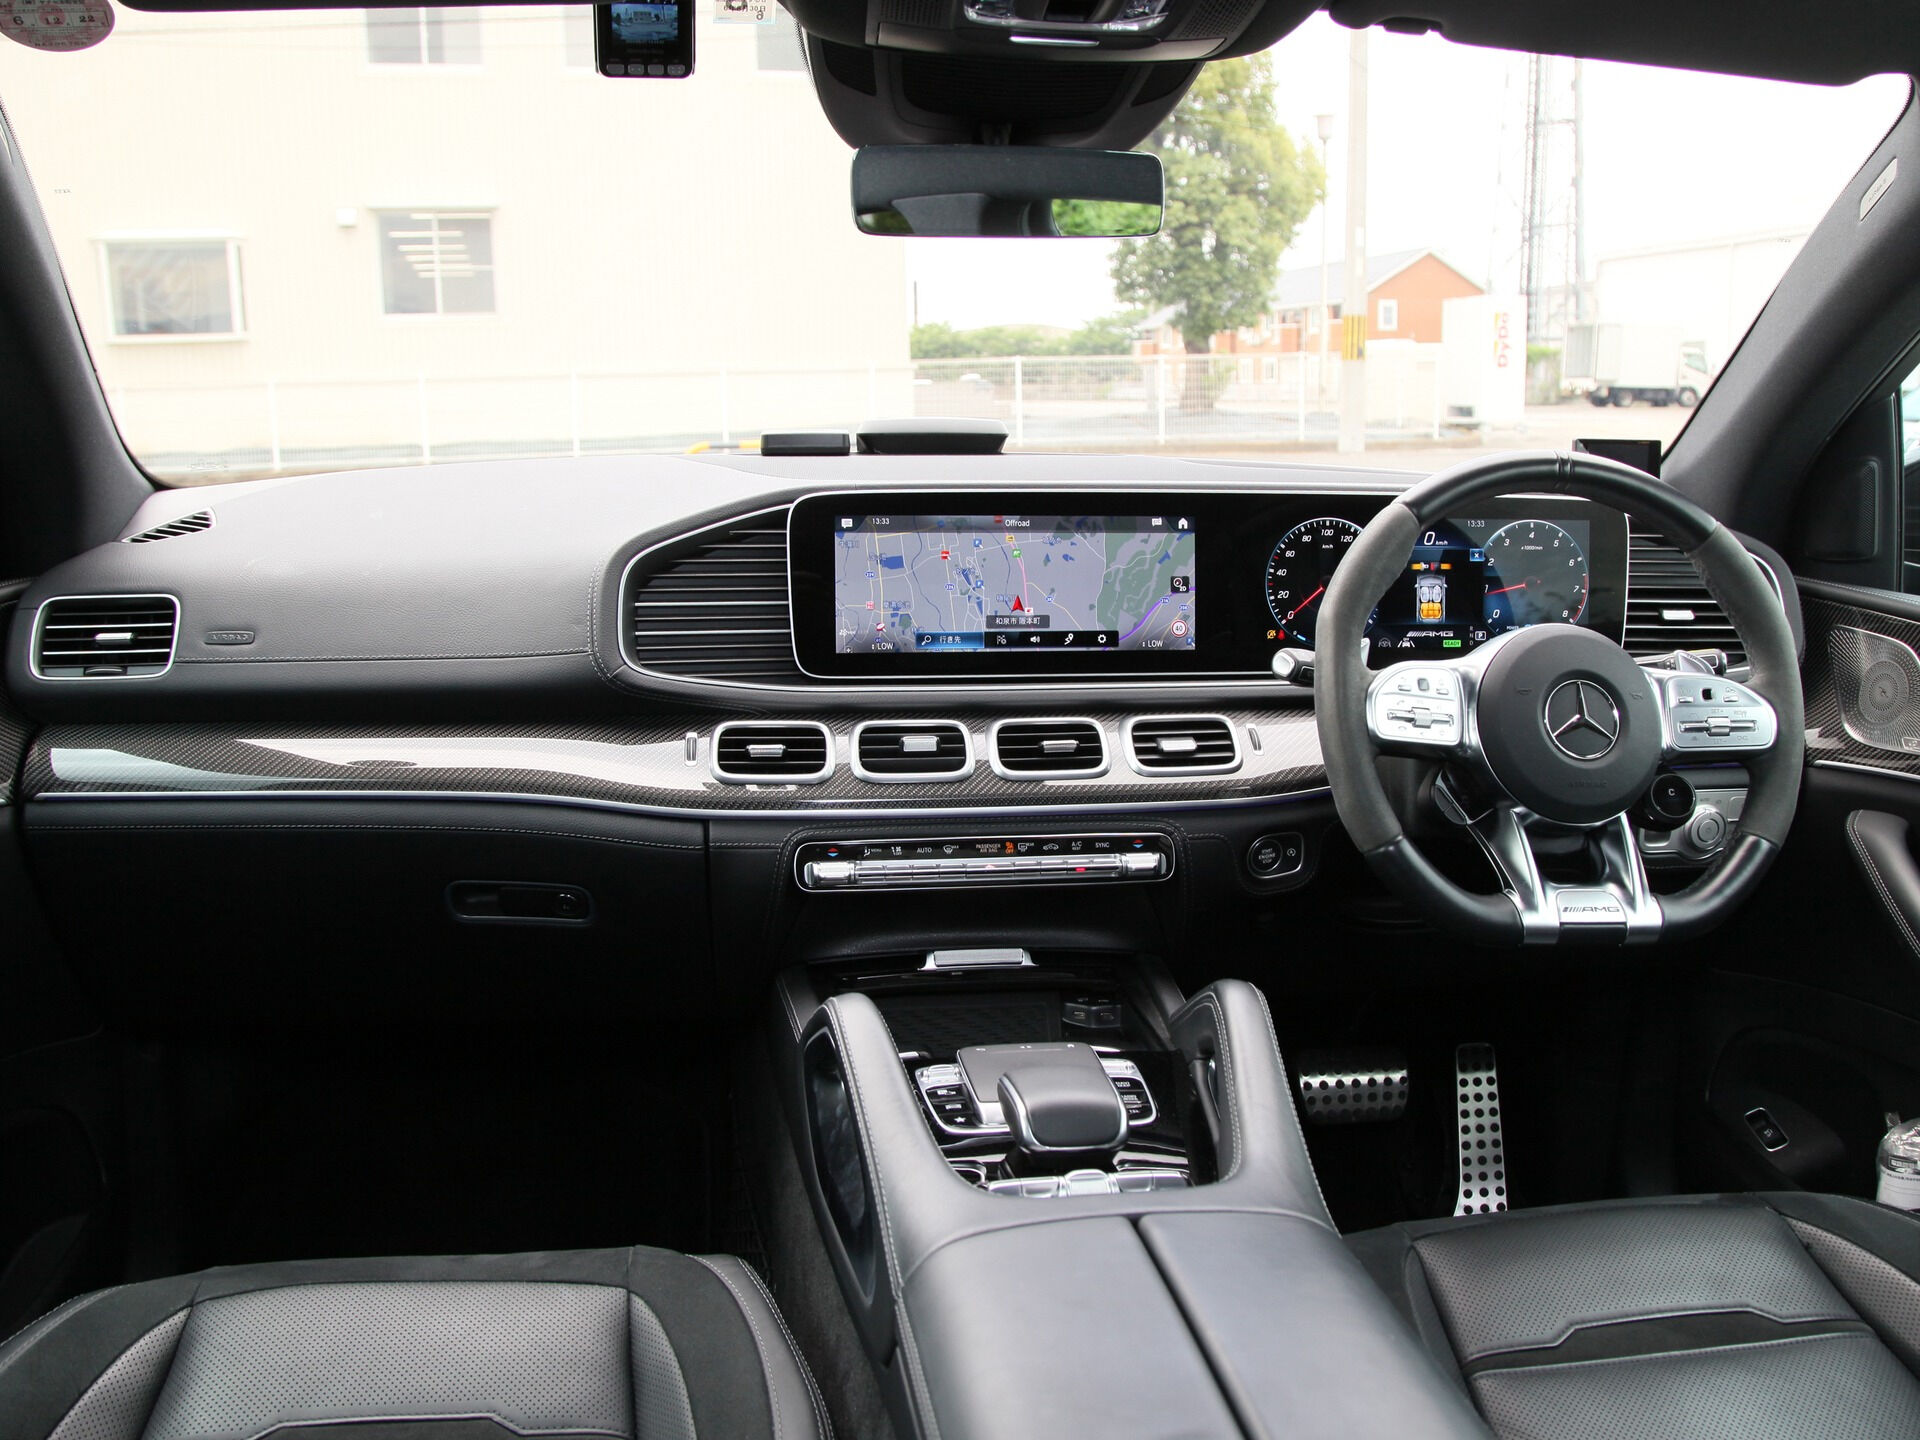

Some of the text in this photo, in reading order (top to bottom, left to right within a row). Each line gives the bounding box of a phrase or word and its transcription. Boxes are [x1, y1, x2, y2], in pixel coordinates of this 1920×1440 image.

[13, 15, 95, 25] 6 12 22
[1005, 519, 1030, 527] Offroad
[1467, 520, 1485, 528] 13:33
[1424, 531, 1435, 545] 0
[1529, 531, 1535, 539] 4
[1488, 558, 1495, 566] 2
[1484, 584, 1489, 593] 1
[1277, 591, 1289, 599] 20
[1287, 611, 1294, 619] 0
[1493, 609, 1500, 617] 0
[995, 617, 1017, 625] 和泉市
[940, 636, 961, 644] 行き先
